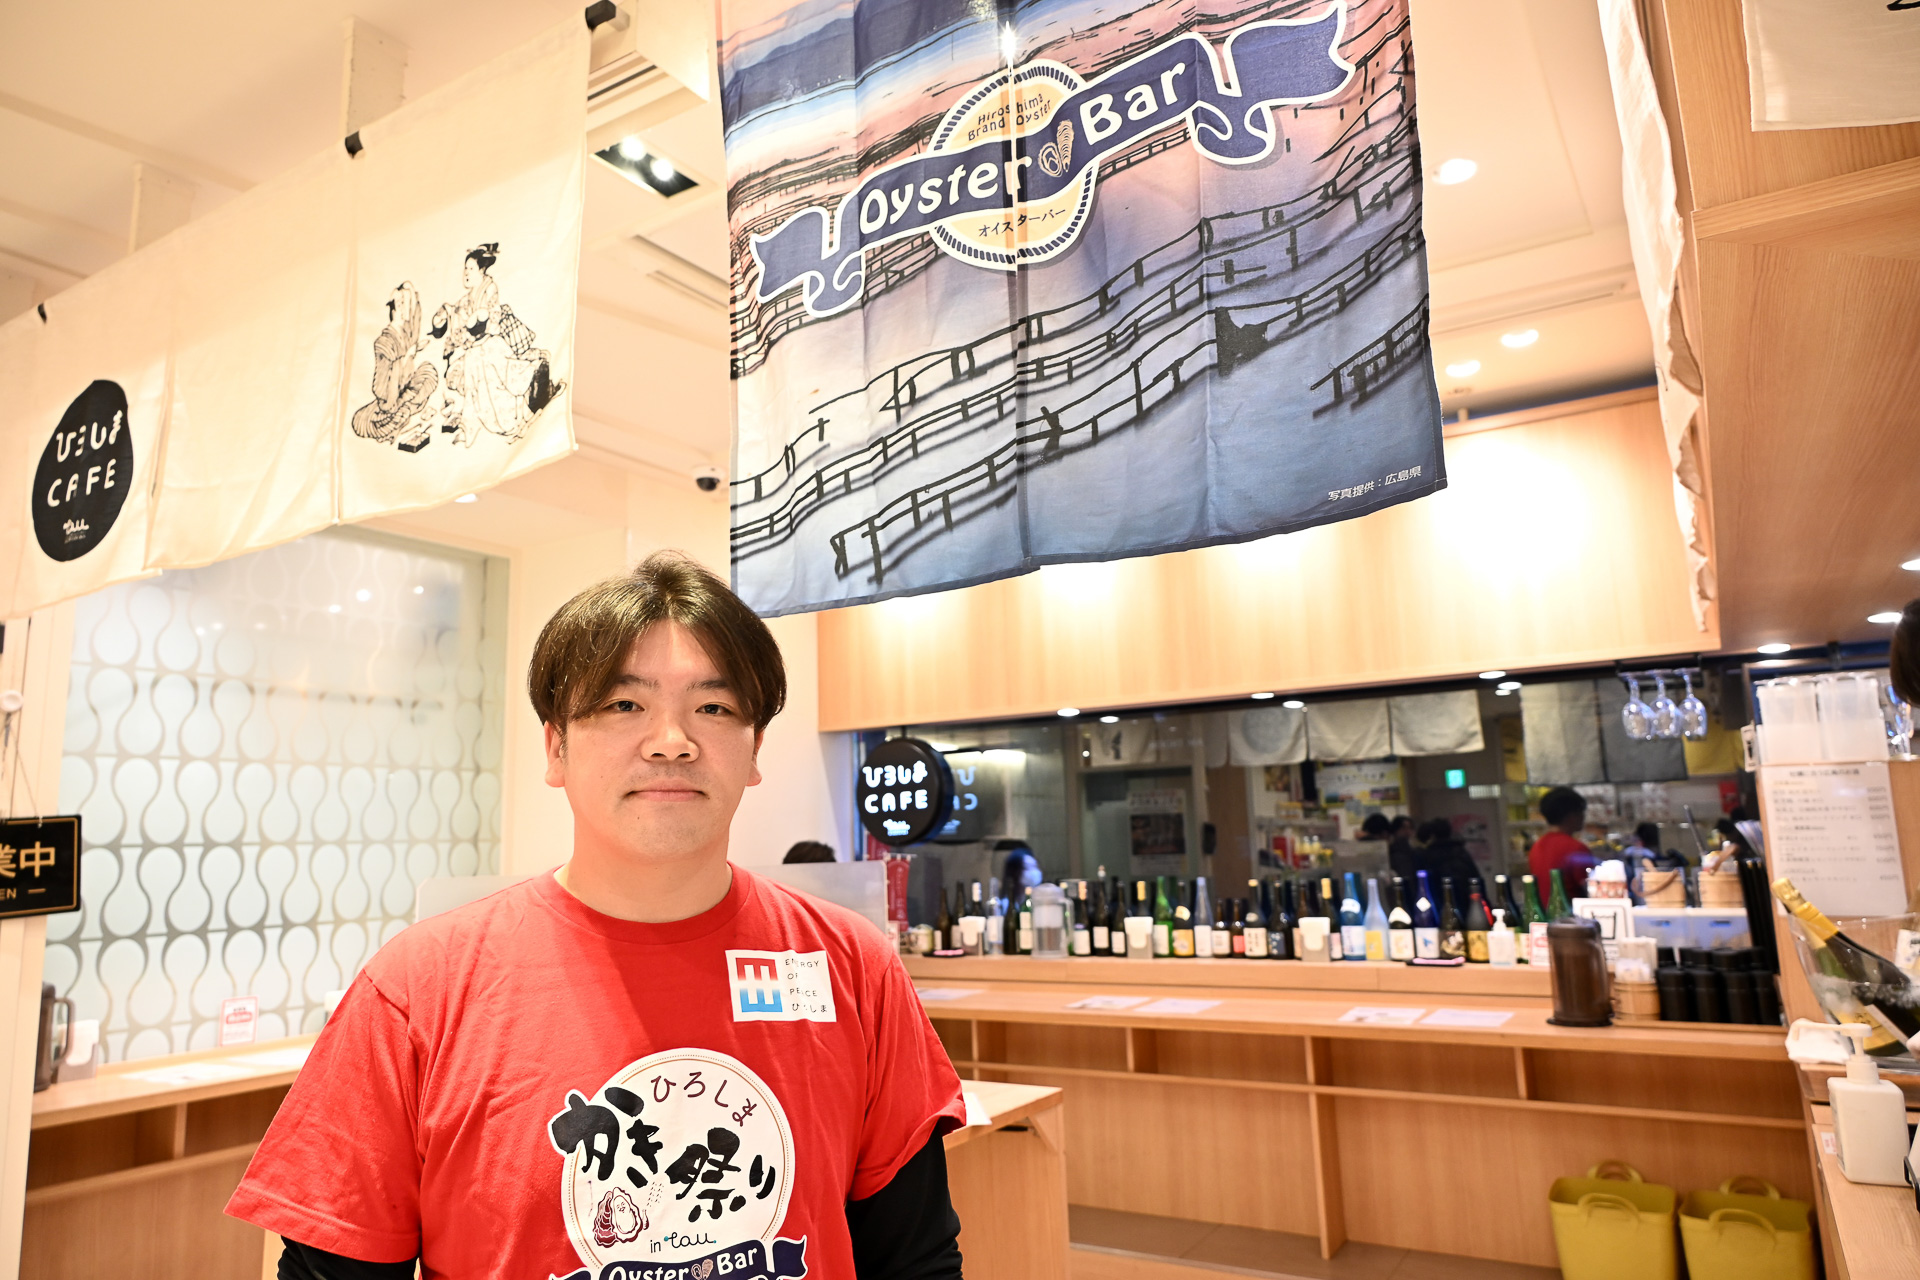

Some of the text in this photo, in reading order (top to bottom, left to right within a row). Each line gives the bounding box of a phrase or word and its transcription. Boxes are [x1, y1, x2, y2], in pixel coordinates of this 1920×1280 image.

[967, 99, 1051, 142] Brand Oyster
[977, 93, 1044, 126] Hiroshima
[859, 61, 1187, 236] Oyster Bar
[978, 208, 1067, 238] オイスターバー
[46, 458, 118, 508] CAFE
[861, 759, 929, 789] ひろしま
[863, 788, 929, 814] CAFE
[784, 957, 820, 968] ENRGY
[789, 987, 818, 997] PECE
[791, 1002, 828, 1013] ひしま
[650, 1071, 758, 1127] ひろしま
[551, 1086, 777, 1223] かき祭り
[650, 1239, 662, 1254] in
[716, 1247, 758, 1276] Bar
